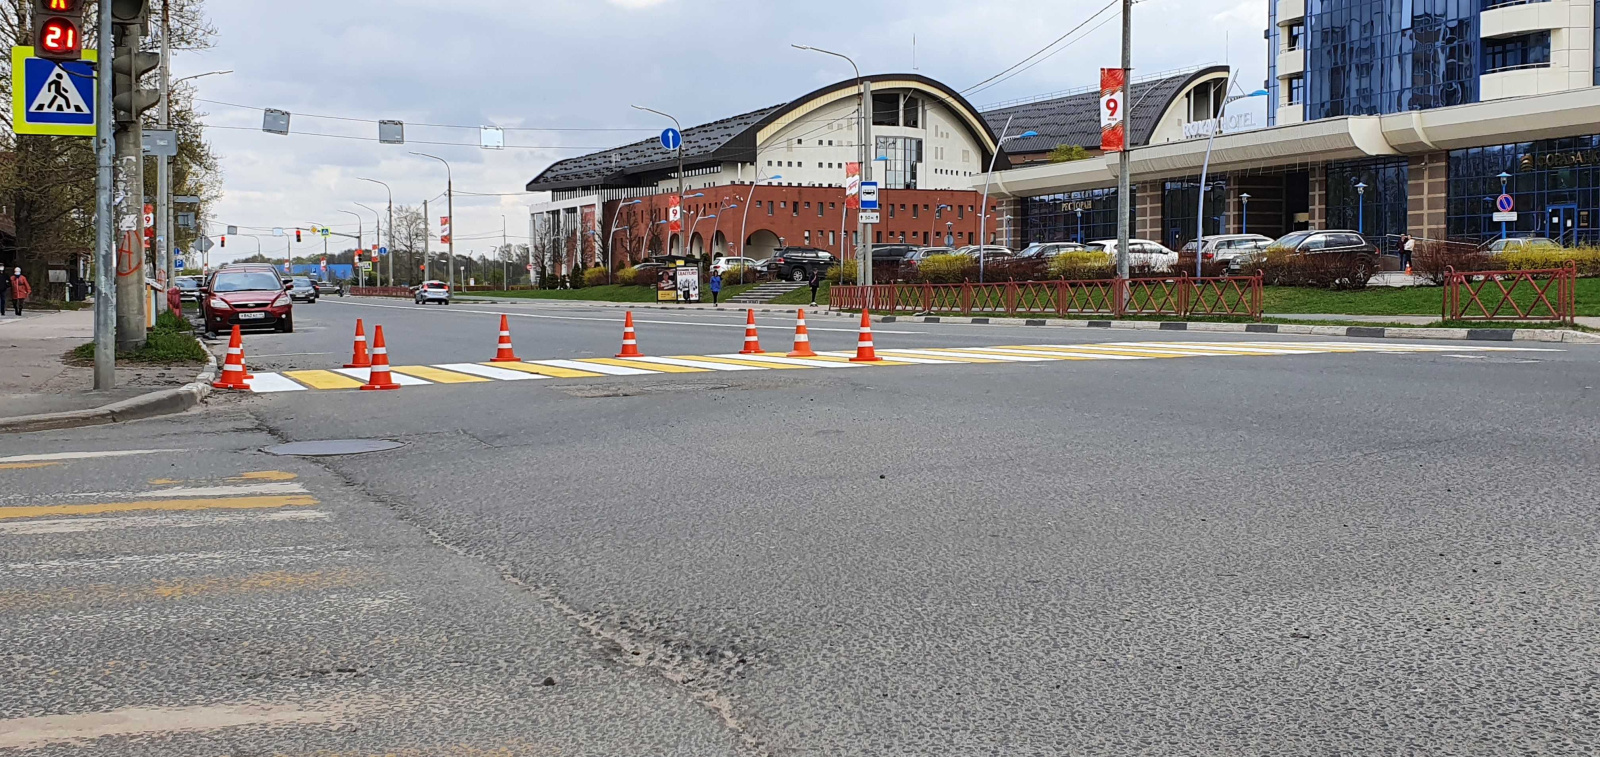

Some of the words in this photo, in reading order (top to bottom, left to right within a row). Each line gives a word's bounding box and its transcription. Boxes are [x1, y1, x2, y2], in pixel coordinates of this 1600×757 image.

[46, 26, 74, 48] 21
[1105, 98, 1119, 117] 9
[1221, 112, 1256, 132] HOTEL
[144, 215, 151, 224] 9
[671, 208, 678, 217] 9
